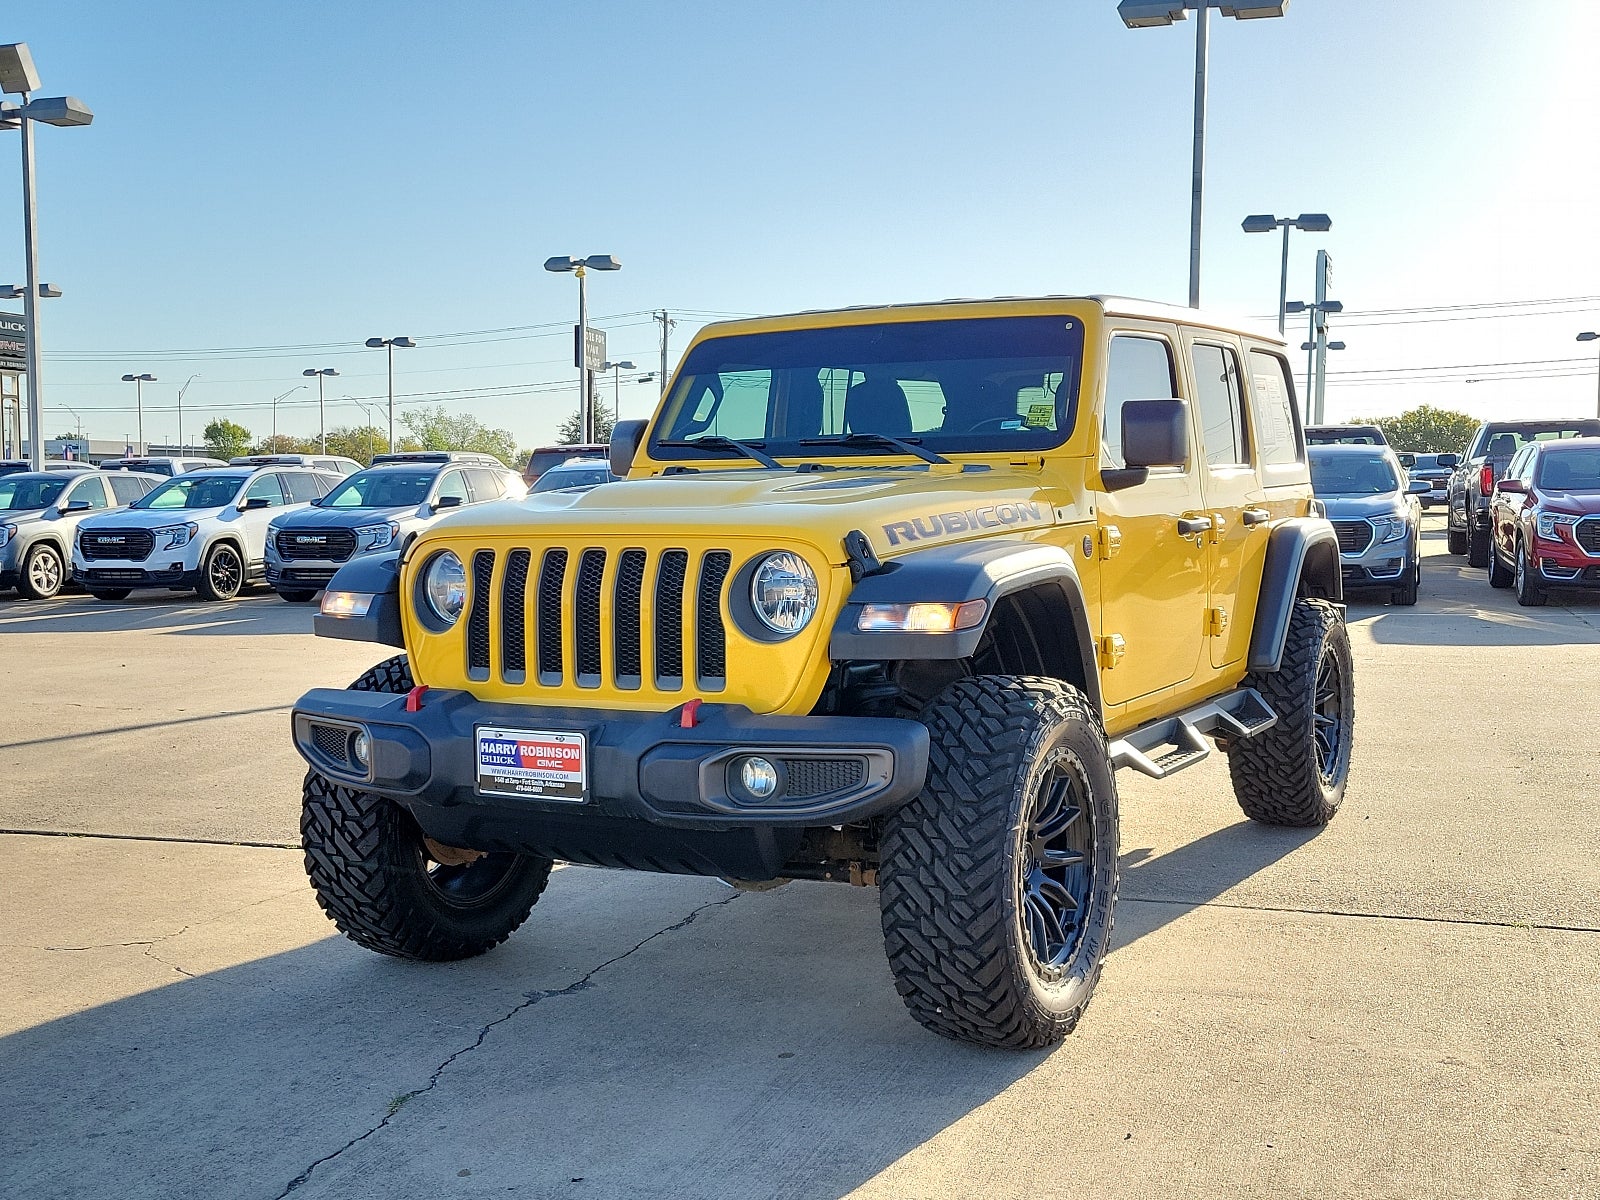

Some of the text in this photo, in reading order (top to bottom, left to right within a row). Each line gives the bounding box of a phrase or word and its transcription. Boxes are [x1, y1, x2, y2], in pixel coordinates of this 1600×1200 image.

[0, 320, 26, 332] UICK
[881, 500, 1041, 547] RUBICON
[296, 535, 327, 544] GMC
[480, 742, 580, 760] HARRY ROBINSON
[481, 754, 564, 768] BUICK GMC
[490, 768, 569, 780] WWW.HARRYROBINSON.COM
